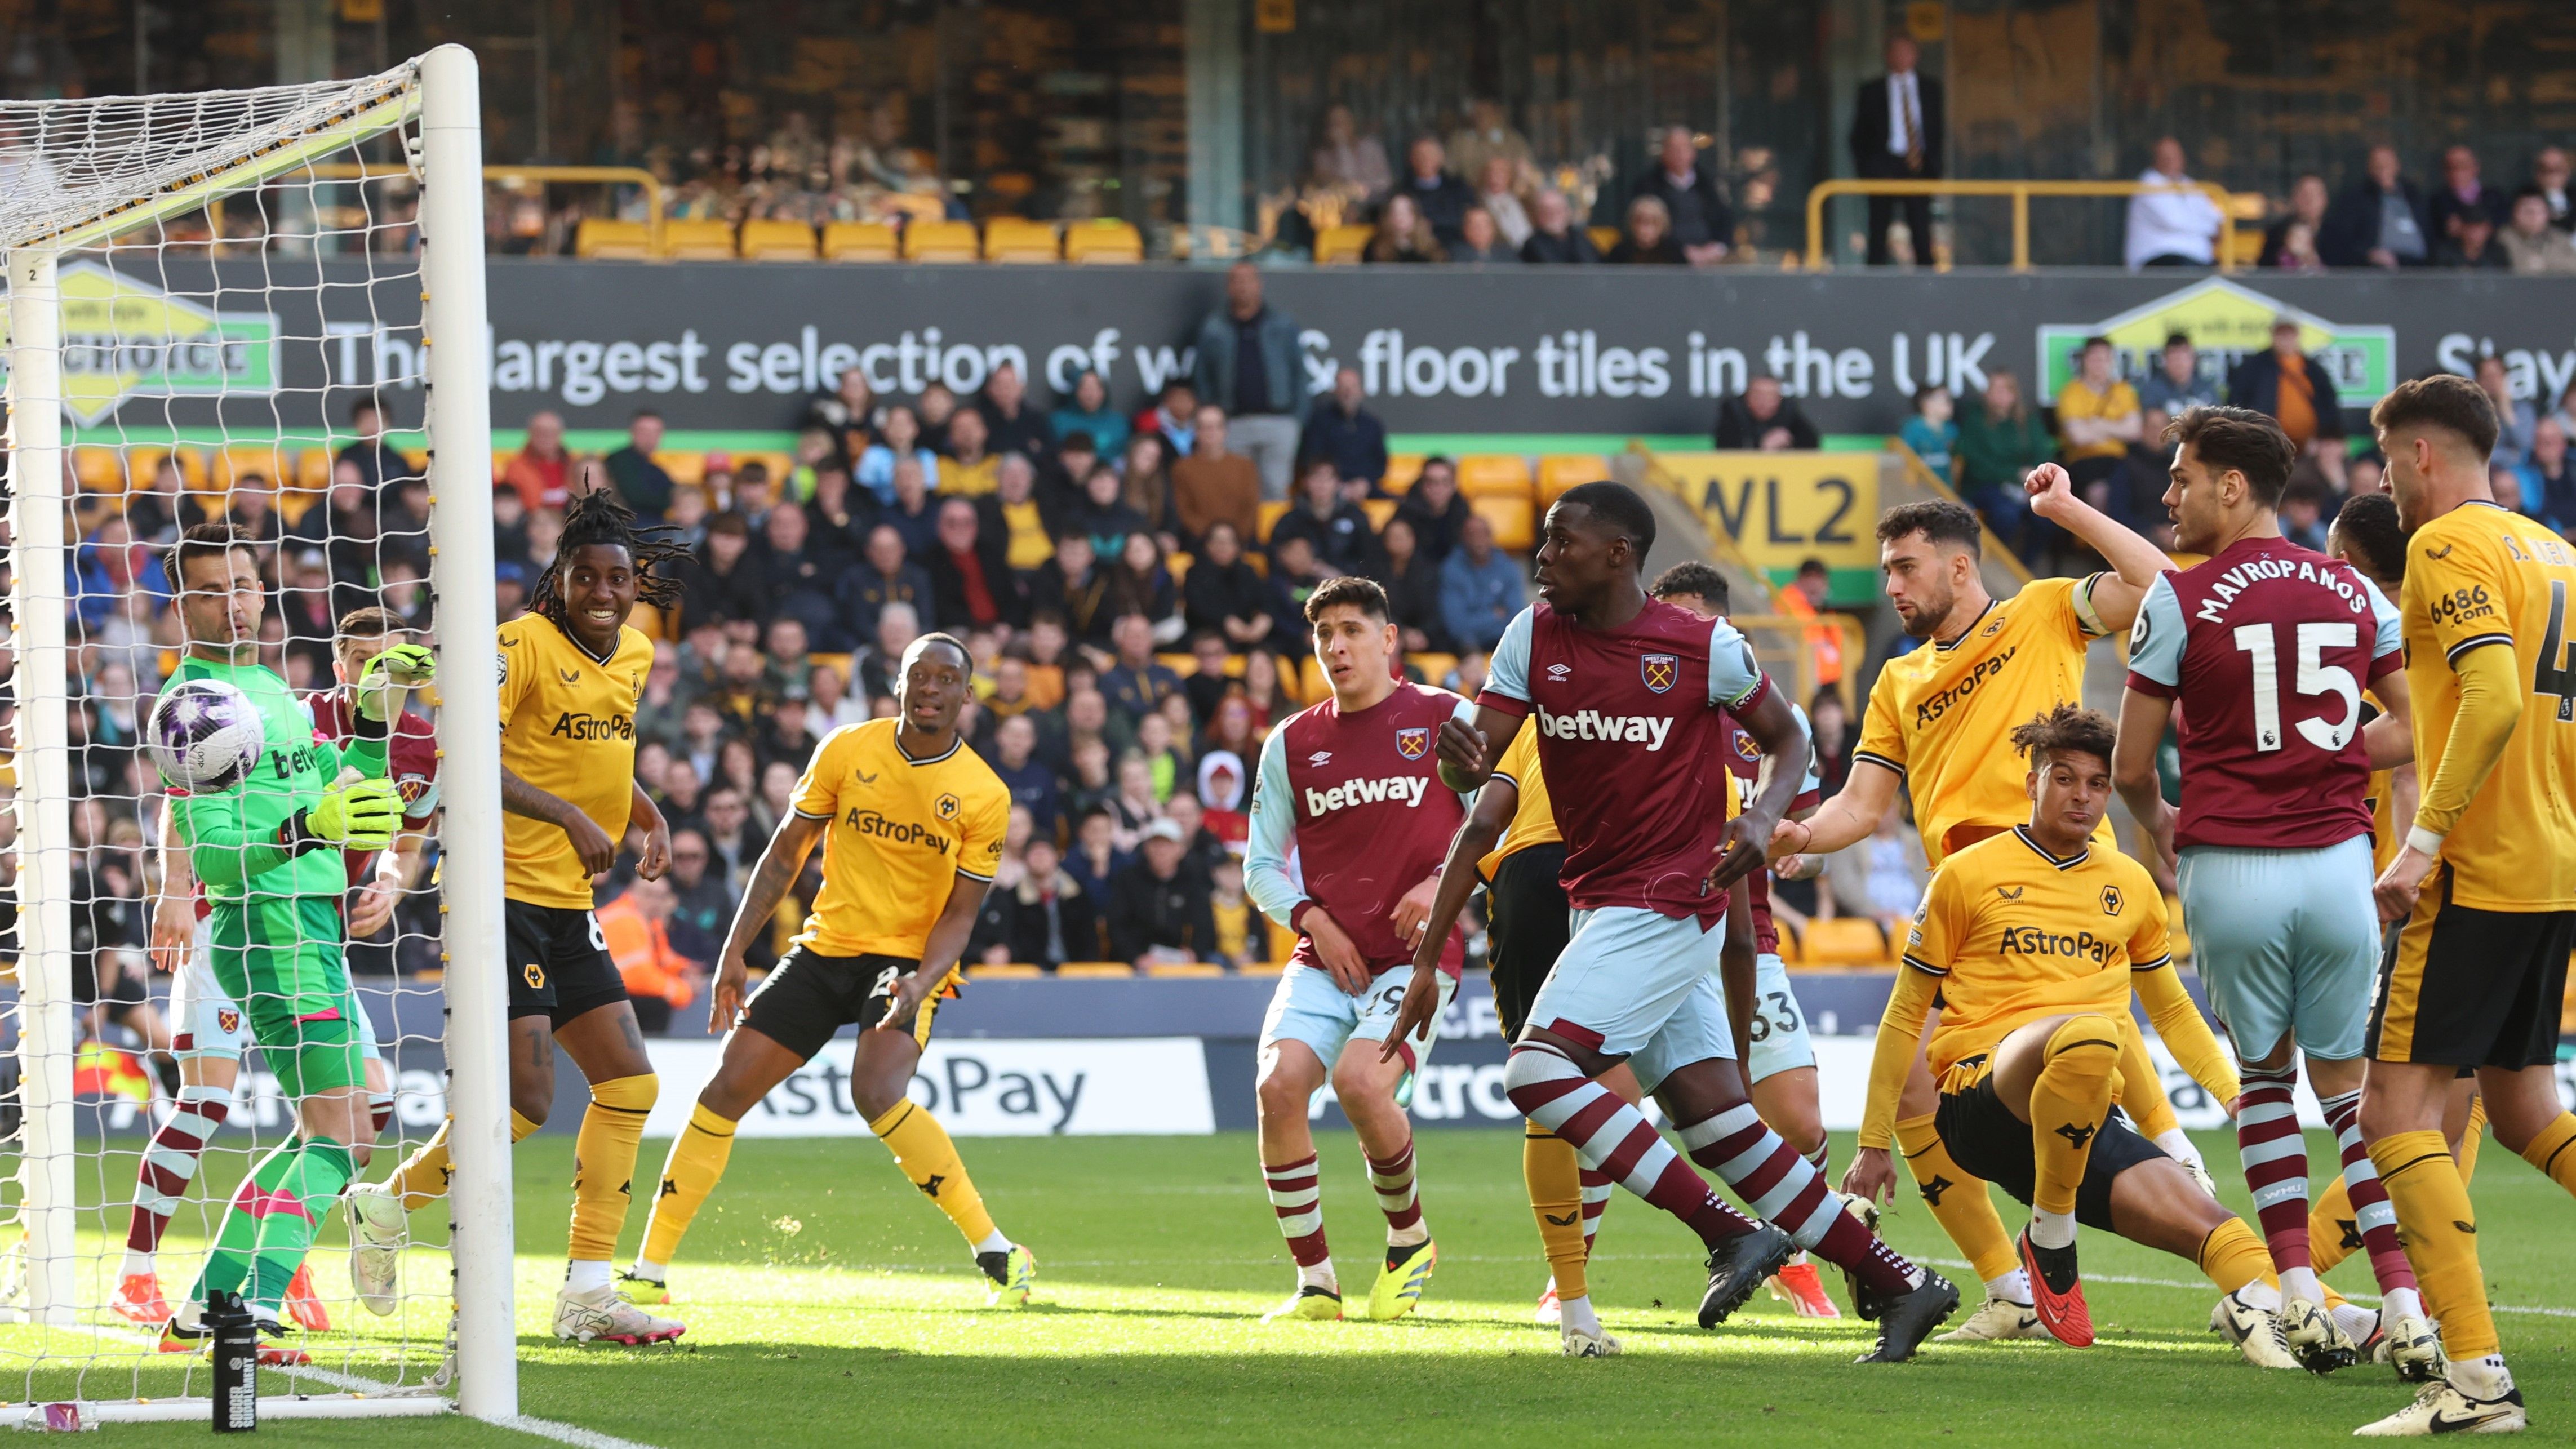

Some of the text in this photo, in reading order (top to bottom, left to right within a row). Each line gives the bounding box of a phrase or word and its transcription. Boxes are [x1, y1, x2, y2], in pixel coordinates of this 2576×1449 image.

[30, 270, 37, 281] 2
[486, 322, 709, 406] largest
[726, 324, 1029, 395] selection
[1046, 327, 1121, 395] of
[1297, 329, 1339, 397] &
[1360, 329, 1521, 398] floor
[1534, 329, 1671, 399] tiles
[1687, 330, 1748, 398] in
[1766, 332, 1875, 399] the
[1891, 332, 1997, 399] UK
[2196, 558, 2366, 624] MAVROPANOS
[2430, 584, 2489, 625] 6686
[2450, 604, 2494, 628] .com
[1916, 646, 2016, 731] AstroPay
[2233, 623, 2361, 752] 15
[1537, 704, 1675, 752] betway
[1305, 776, 1429, 817] betway
[846, 807, 951, 855] AstroPay
[1999, 927, 2118, 970] AstroPay
[2264, 1185, 2302, 1200] WHU
[229, 1386, 244, 1428] SOCCER
[243, 1357, 255, 1428] SUPPLEMENT
